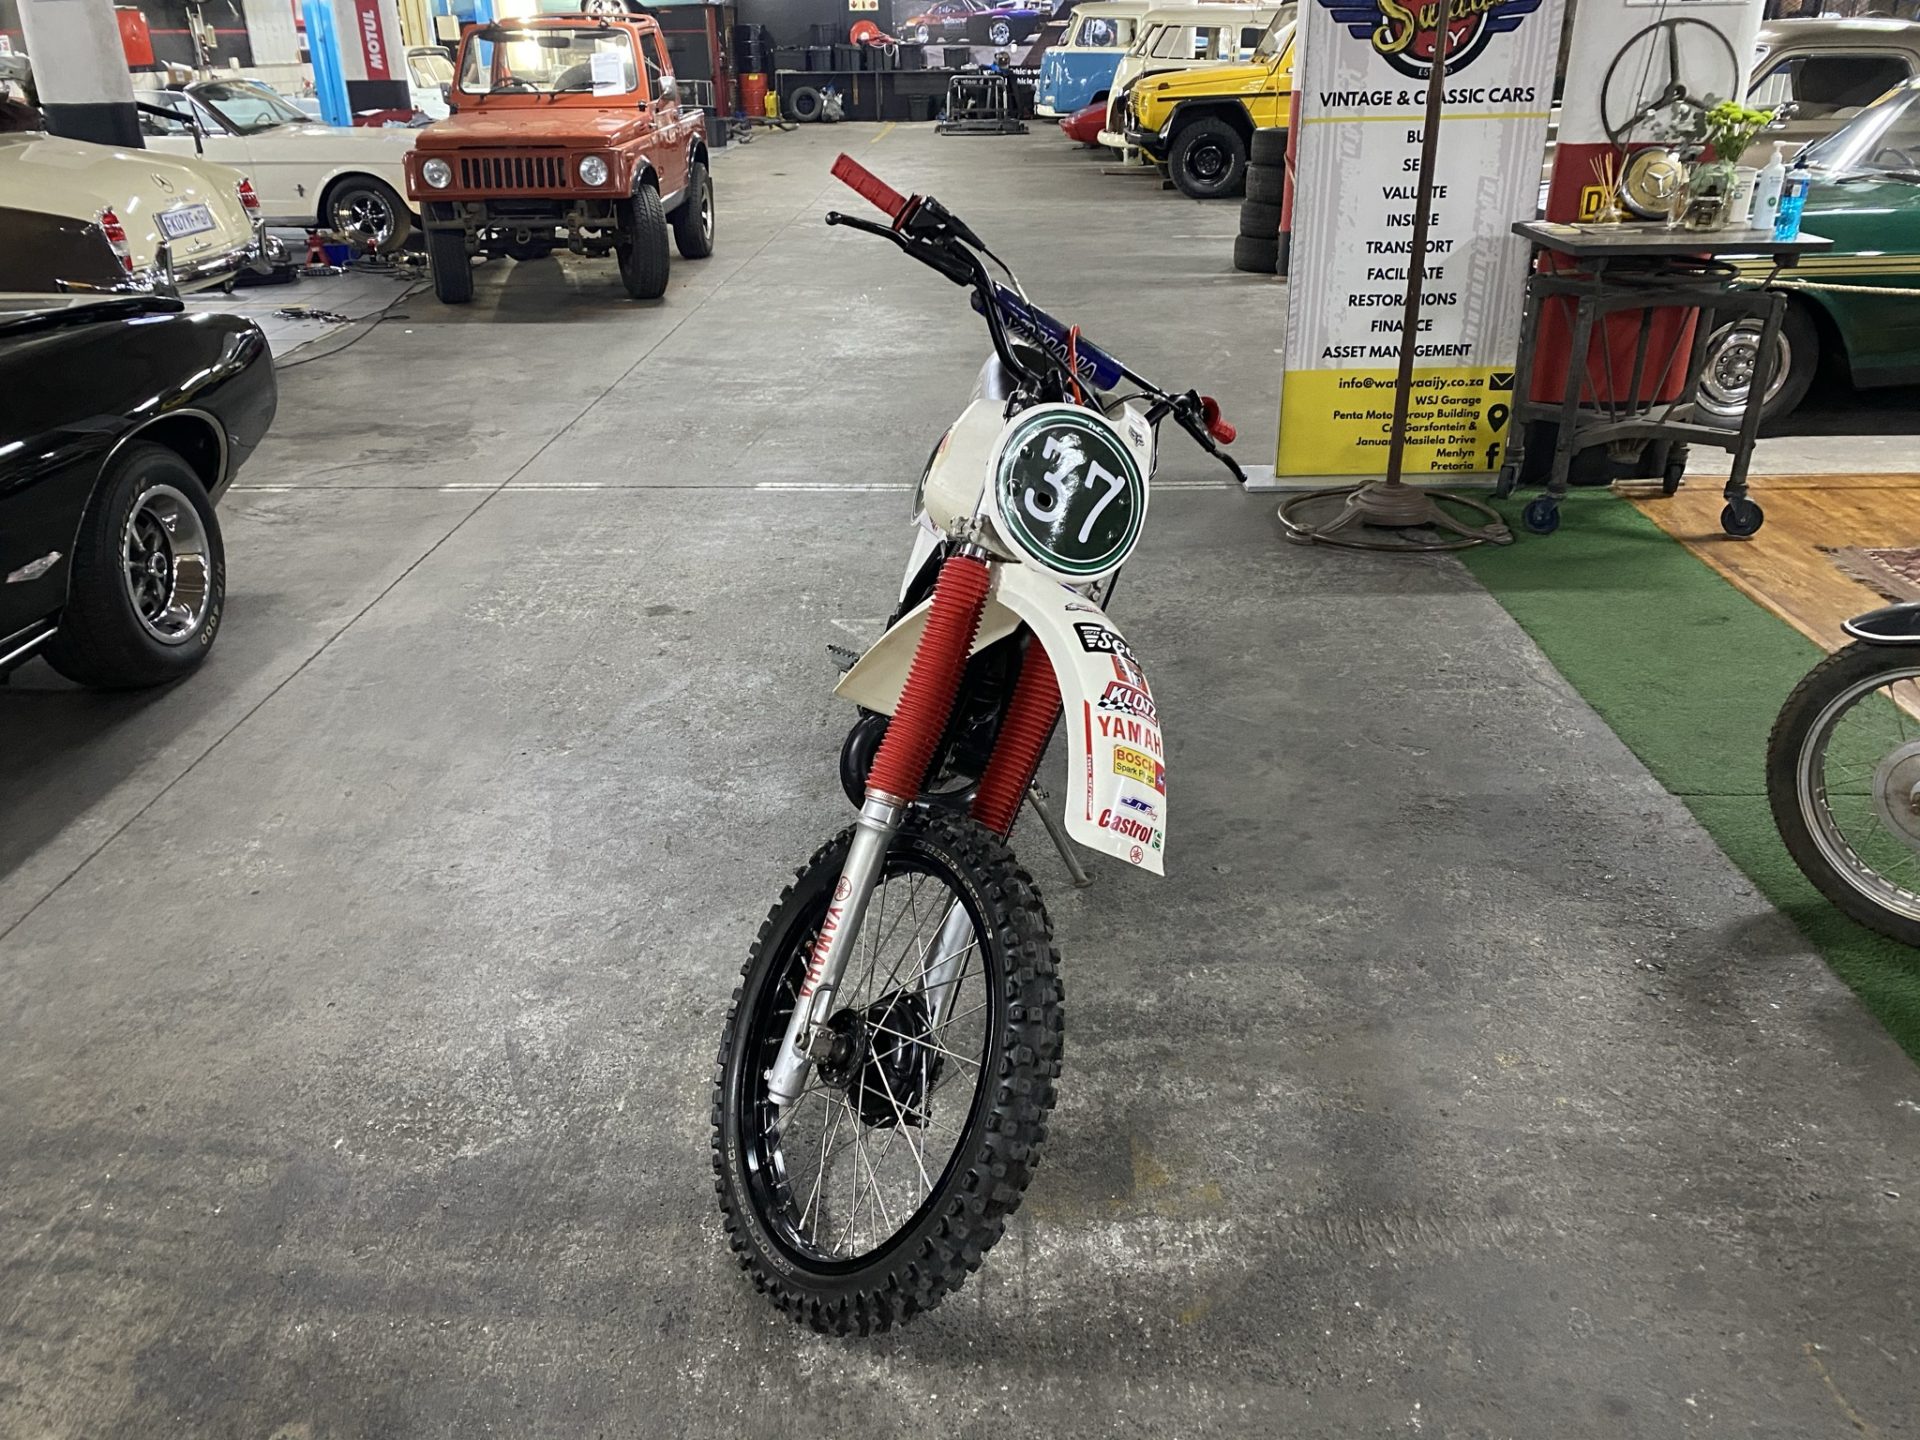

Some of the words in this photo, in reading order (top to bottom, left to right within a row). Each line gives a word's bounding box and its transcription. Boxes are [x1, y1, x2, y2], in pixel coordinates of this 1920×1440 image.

[362, 9, 385, 70] MOTUL
[1320, 91, 1393, 107] VINTAGE
[1397, 91, 1410, 105] &
[1414, 88, 1484, 105] CSSIC
[1488, 87, 1535, 103] CARS
[1407, 130, 1424, 143] BU
[1402, 158, 1420, 171] SE
[1382, 185, 1448, 200] VALUTE
[1386, 213, 1440, 227] INSE
[1366, 240, 1454, 254] TRANSORT
[1367, 266, 1444, 280] FACILIATE
[1348, 292, 1457, 307] RESTORIONS
[1371, 319, 1434, 333] FINACE
[1321, 345, 1367, 359] ASSET
[1369, 343, 1472, 358] MANGEMENT
[1415, 396, 1438, 405] WSJ
[1441, 396, 1482, 407] Garage
[1333, 411, 1363, 420] Penta
[1366, 411, 1393, 420] Moto
[1405, 411, 1434, 421] roup
[1437, 409, 1480, 420] Building
[1404, 422, 1466, 433] Garsfontein
[1468, 421, 1477, 431] &
[1448, 435, 1476, 444] Drive
[1436, 448, 1475, 458] Menlyn
[1431, 461, 1474, 471] Pretoria
[1024, 434, 1126, 544] 37
[1109, 686, 1157, 720] KLOTZ
[1097, 715, 1164, 758] YAMAH
[1117, 749, 1155, 773] BOSCH
[1116, 762, 1137, 776] Spark
[1098, 808, 1153, 844] Castrol
[800, 907, 843, 997] YAMAHA
